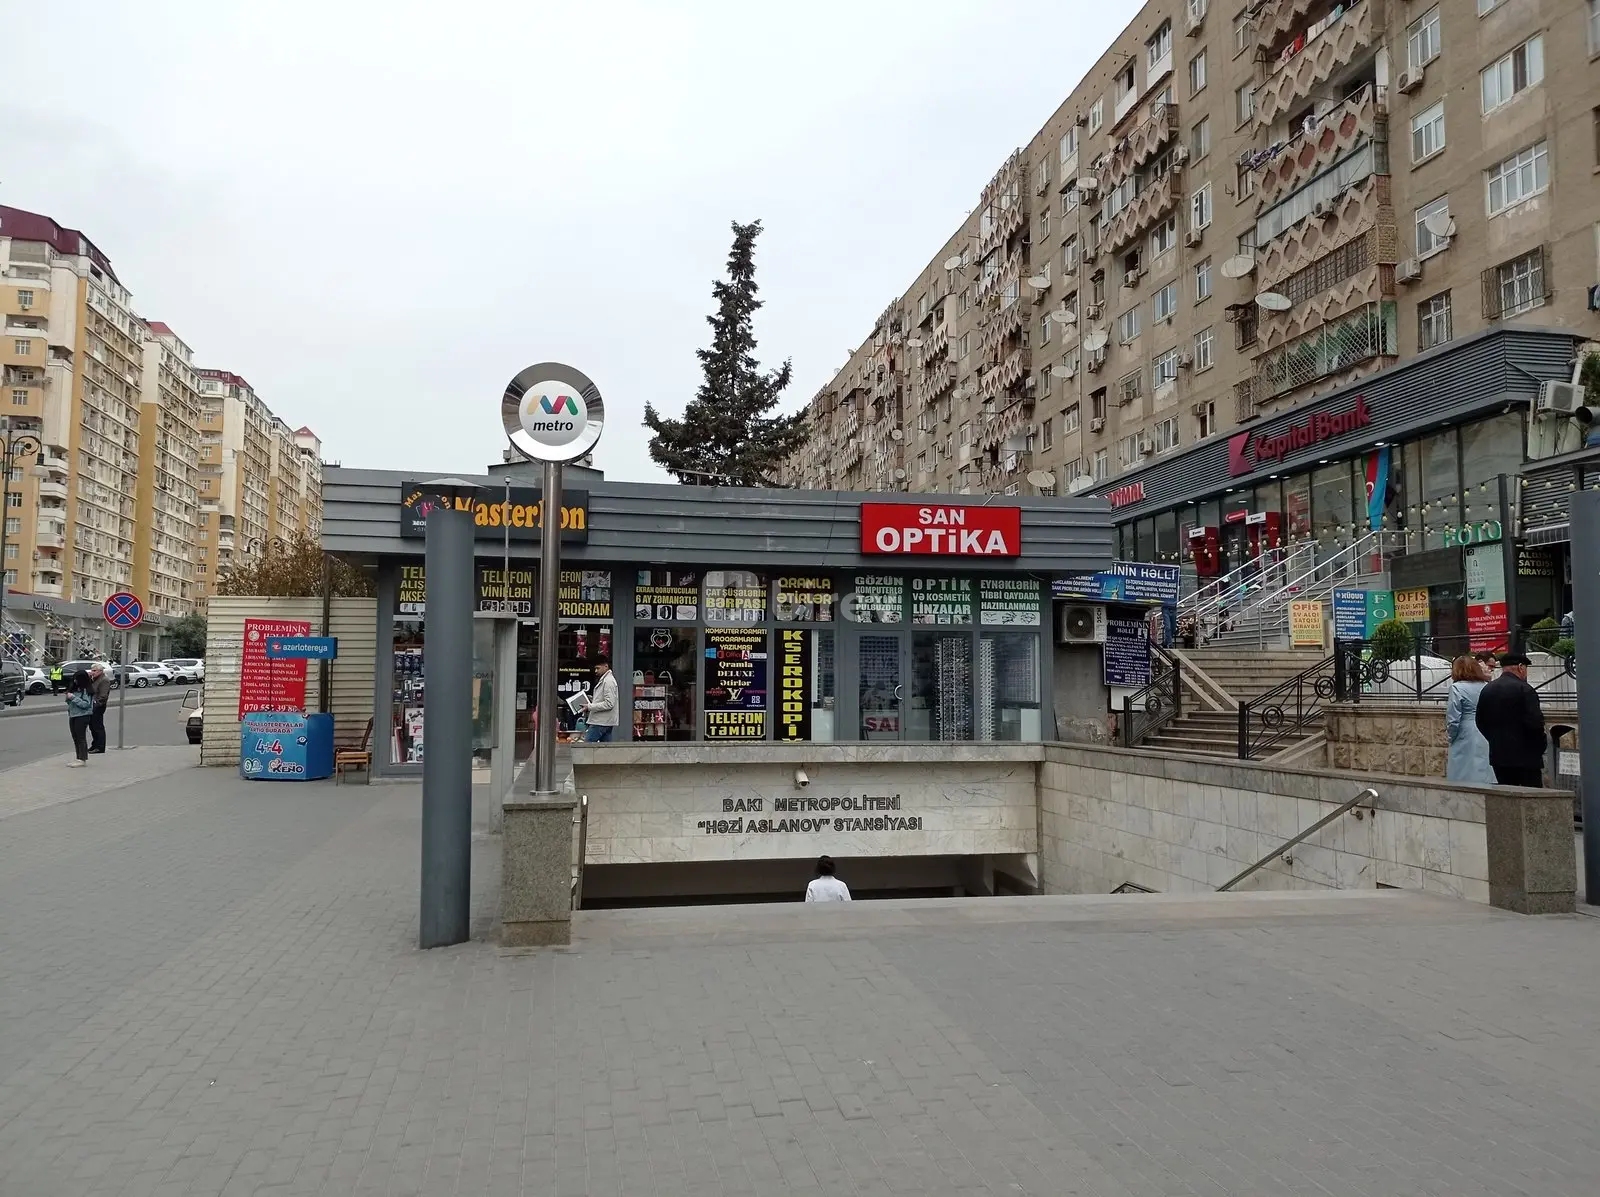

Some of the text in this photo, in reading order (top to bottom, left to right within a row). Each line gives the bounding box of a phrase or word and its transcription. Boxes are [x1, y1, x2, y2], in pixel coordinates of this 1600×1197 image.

[533, 420, 574, 431] metro
[1254, 395, 1371, 463] Kapital Bank
[918, 508, 965, 525] SAN
[1444, 520, 1502, 548] FOTO
[401, 566, 426, 578] TEL
[560, 571, 581, 582] EFON
[1141, 568, 1175, 580] HƏLLİ
[778, 578, 831, 589] QRAMLA
[855, 575, 903, 586] GÖZÜN
[980, 580, 1039, 590] EYNƏKLƏRİN
[400, 590, 426, 602] AKSES
[559, 586, 580, 599] MİRİ
[777, 590, 832, 604] ƏTİRLƏR
[913, 591, 971, 602] VƏ KOSMETİK
[980, 590, 1039, 601] TİBBİ QAYDADA
[1397, 591, 1427, 602] OFIS
[636, 594, 697, 605] 6 AY ZƏMANƏTLƏ
[706, 597, 766, 609] BƏRPASI
[856, 595, 902, 604] TƏYİNİ
[913, 601, 971, 614] LİNZALAR
[981, 601, 1039, 611] HAZIRLANMASI
[1373, 595, 1388, 626] FO
[247, 623, 307, 633] PROBLEMİNİN
[719, 661, 753, 669] Qramla
[708, 713, 763, 724] TELEFON
[710, 725, 762, 736] TƏMİRİ
[255, 739, 283, 755] 4+4
[272, 764, 304, 774] KENO
[722, 795, 901, 813] BAKI METROPOLİTENİ
[833, 815, 922, 831] STANSİYASI
